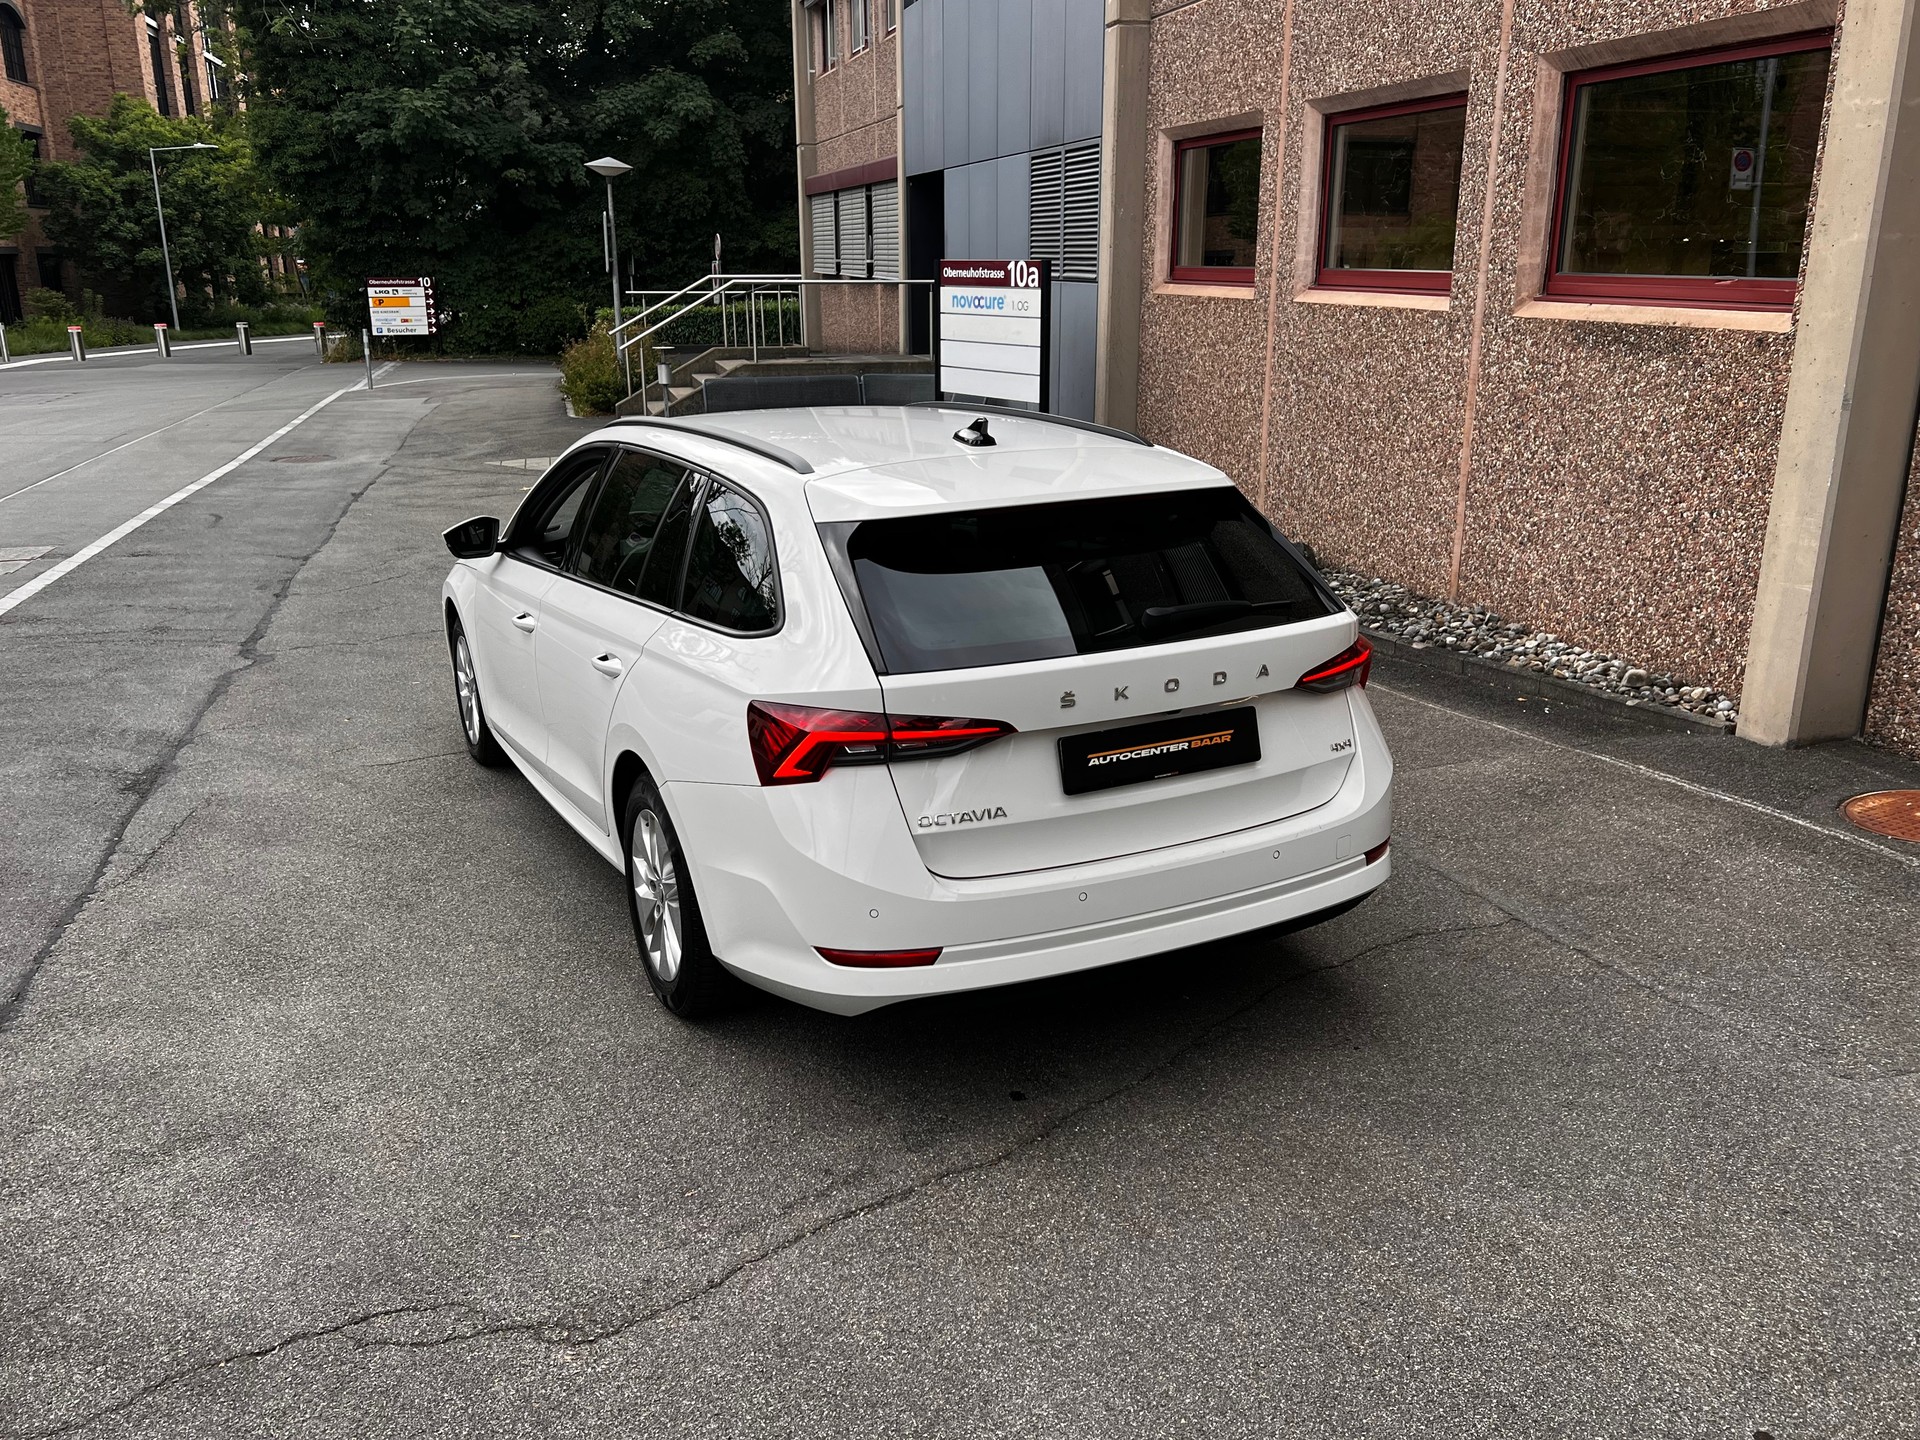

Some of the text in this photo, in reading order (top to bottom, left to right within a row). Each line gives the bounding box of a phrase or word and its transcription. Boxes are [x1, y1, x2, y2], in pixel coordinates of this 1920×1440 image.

[418, 277, 431, 288] 10
[943, 260, 1039, 288] Oberneuhofstrasse 10a
[1060, 663, 1270, 709] ŠKODA
[1088, 735, 1232, 766] AUTOCENTER BAAR
[918, 806, 1008, 828] OCTAVIA
